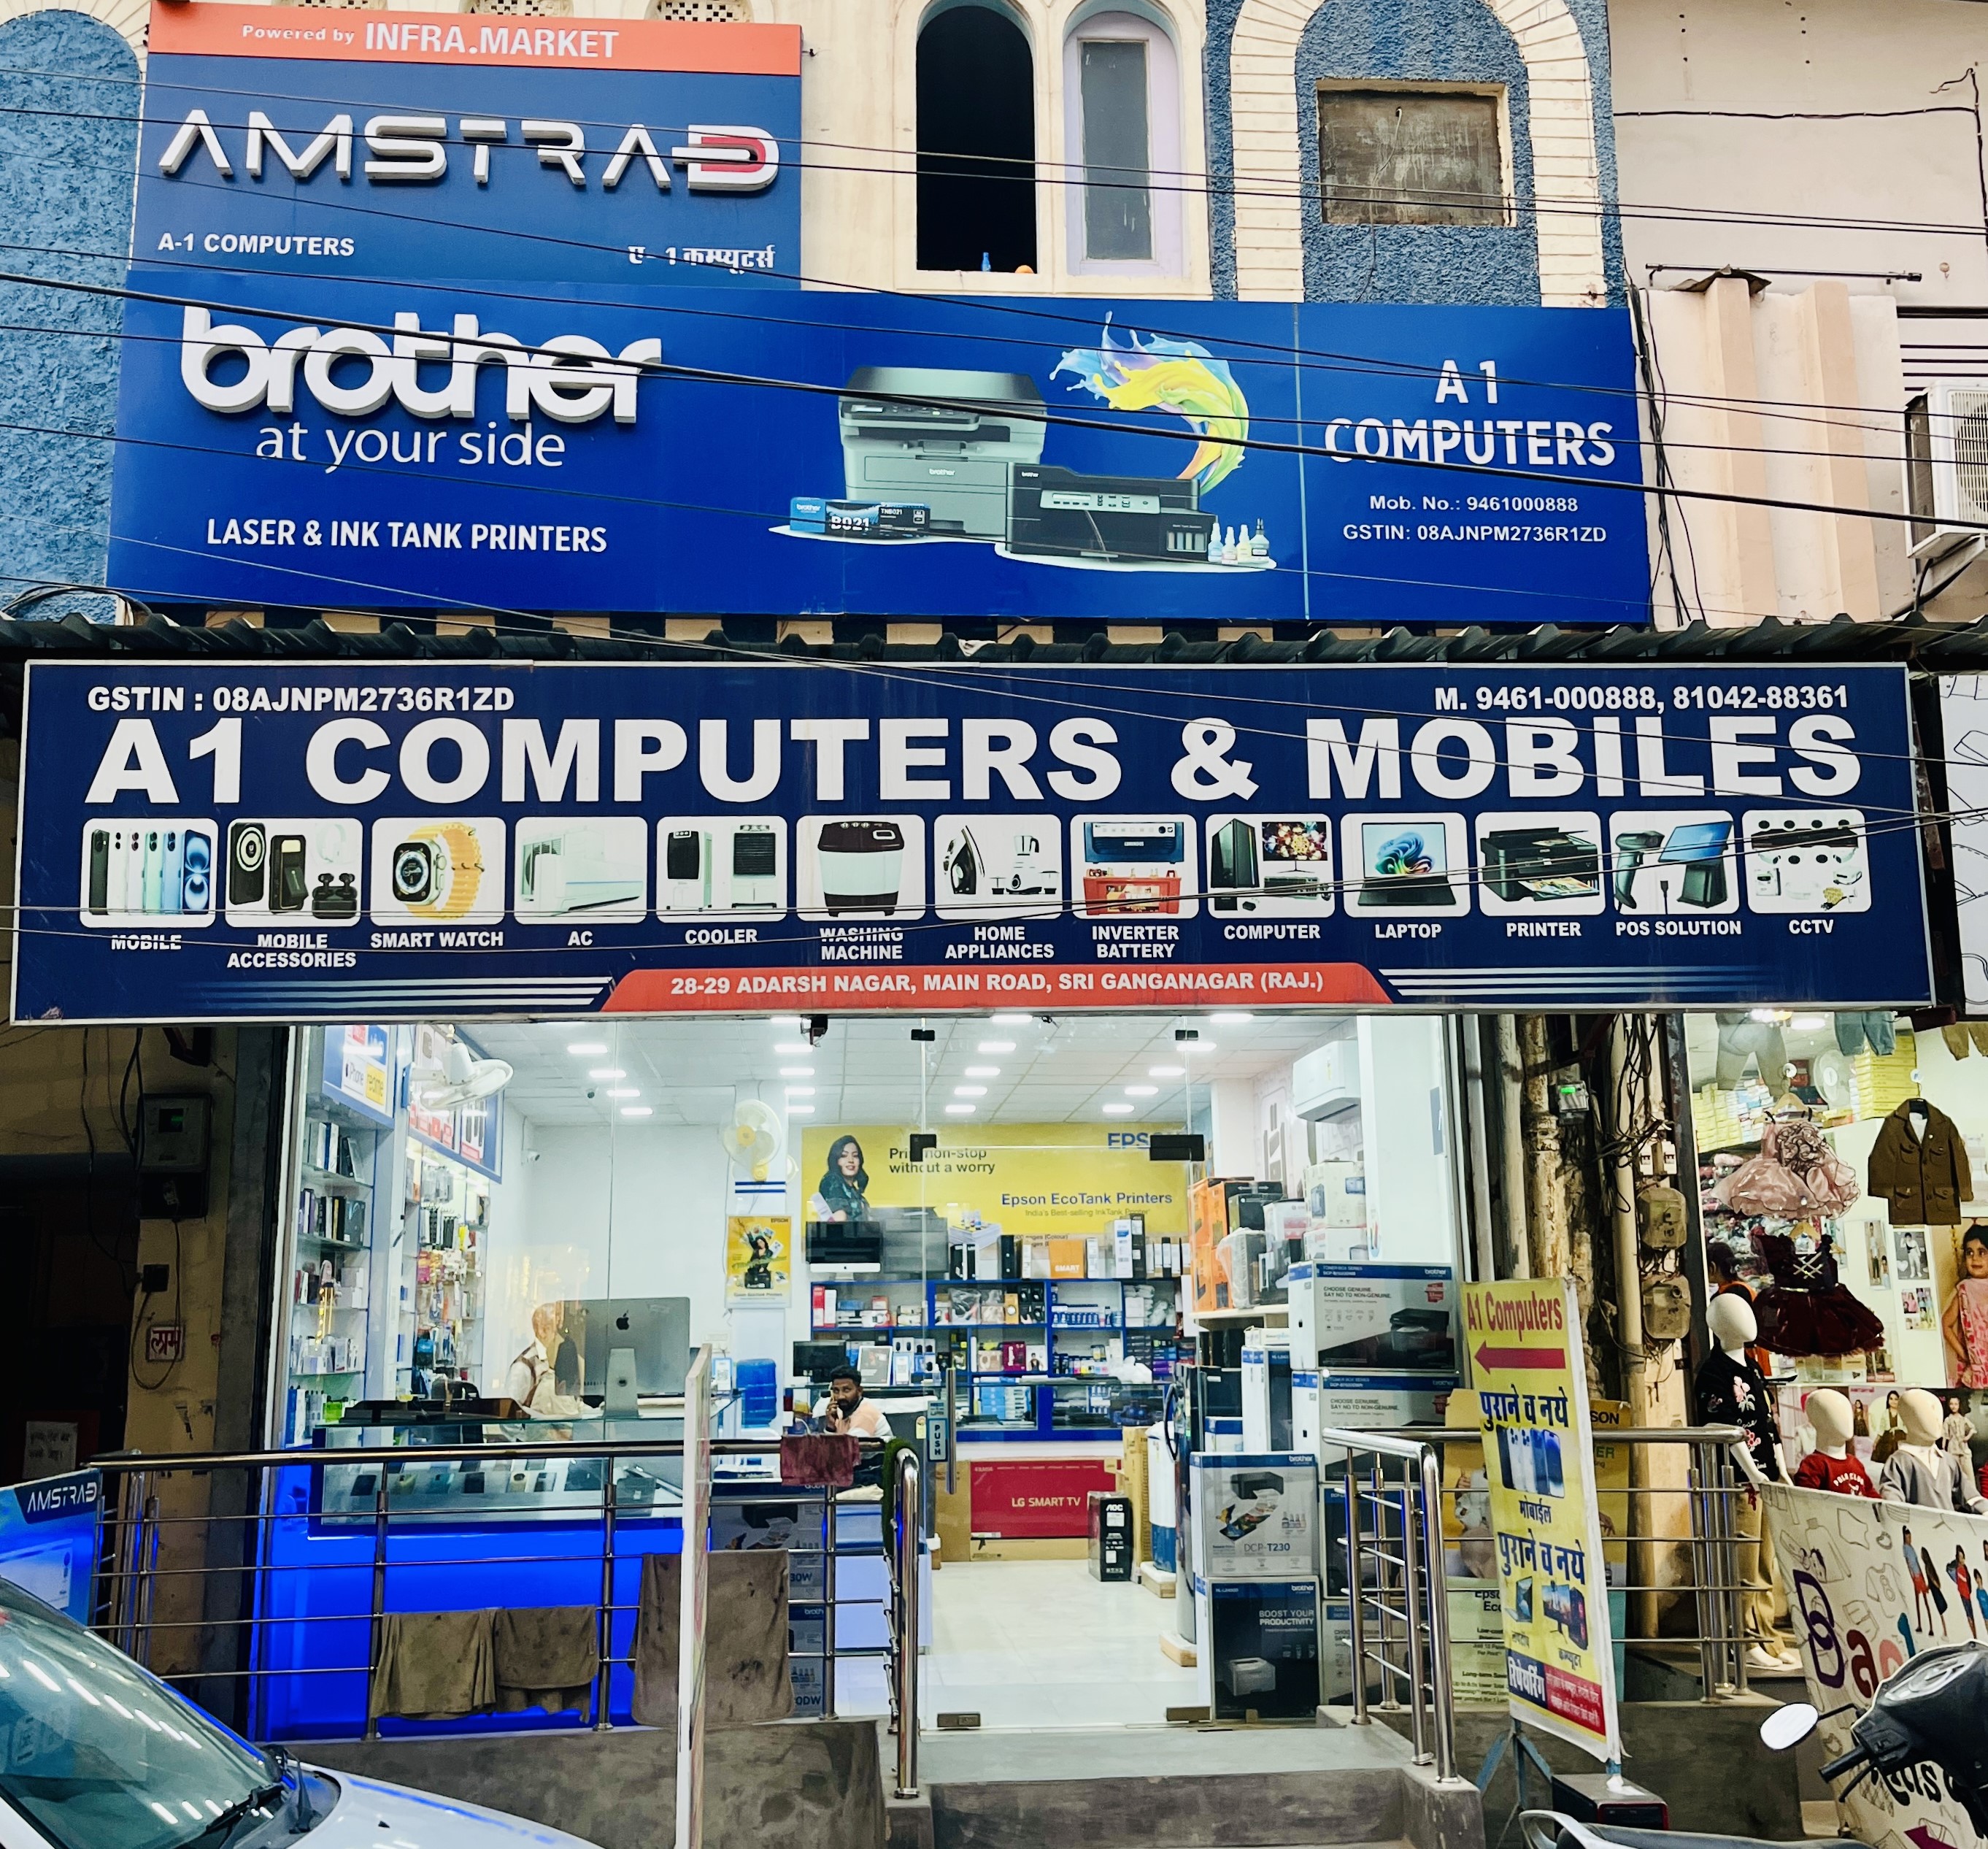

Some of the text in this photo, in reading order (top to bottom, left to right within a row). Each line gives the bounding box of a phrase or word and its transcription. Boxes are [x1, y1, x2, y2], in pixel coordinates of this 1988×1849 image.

[239, 21, 620, 58] Powered by INFRA.MARKET
[158, 108, 779, 193] AMSTRAD
[158, 233, 354, 255] A-1 COMPUTERS
[182, 305, 661, 423] brother
[256, 423, 566, 473] at your side
[1325, 418, 1615, 466] COMPUTERS
[1370, 495, 1415, 510] Mob.
[1467, 497, 1577, 511] 9461000888
[208, 519, 606, 552] LASER & INK TANK PRINTERS
[1344, 525, 1606, 541] GSTIN: 08AJNPM2736R1ZD
[88, 687, 183, 710] GSTIN
[214, 688, 514, 711] 08AJNPM2736R1ZD
[1436, 685, 1846, 714] M. 9461-000888, 81042-88361
[85, 715, 1862, 804] A1 COMPUTERS & MOBILES
[820, 926, 904, 943] WASHING
[975, 926, 1025, 940] HOME
[1093, 926, 1179, 939] INVERTER
[1225, 925, 1320, 939] COMPUTER
[1376, 924, 1441, 938] LAPTOP
[1507, 923, 1581, 937] PRINTER
[1617, 921, 1741, 935] POS SOLUTION
[1789, 920, 1833, 934] CCTV
[111, 935, 182, 950] MOBILE
[254, 934, 327, 949] MOBILE
[371, 932, 503, 947] SMART WATCH
[568, 931, 593, 945] AC
[685, 928, 758, 945] COOLER
[822, 945, 902, 959] MACHINE
[945, 945, 1054, 958] APPLIANCES
[1098, 944, 1174, 958] BATTERY
[228, 953, 355, 967] ACCESSORIES
[671, 972, 1322, 994] 28-29 ADARSH NAGAR, MAIN ROAD, SRI GANGANAGAR (RAJ.)
[1108, 1132, 1150, 1149] EPS
[890, 1148, 986, 1160] Pri non-stop
[944, 1164, 952, 1172] a
[956, 1164, 995, 1175] worry
[1001, 1192, 1172, 1207] Epson EcoTank Printers
[1051, 1209, 1093, 1217] Best-selling
[1467, 1291, 1482, 1331] A1
[1485, 1291, 1563, 1342] Computers
[1479, 1384, 1568, 1431] पुराने व नये
[27, 1482, 97, 1513] AMSTRAD
[1012, 1497, 1081, 1507] LG SMART TV
[1519, 1495, 1552, 1524] मोबाईल
[1498, 1529, 1585, 1585] पुराने व नये
[1260, 1618, 1314, 1626] PRODUCTIVITY
